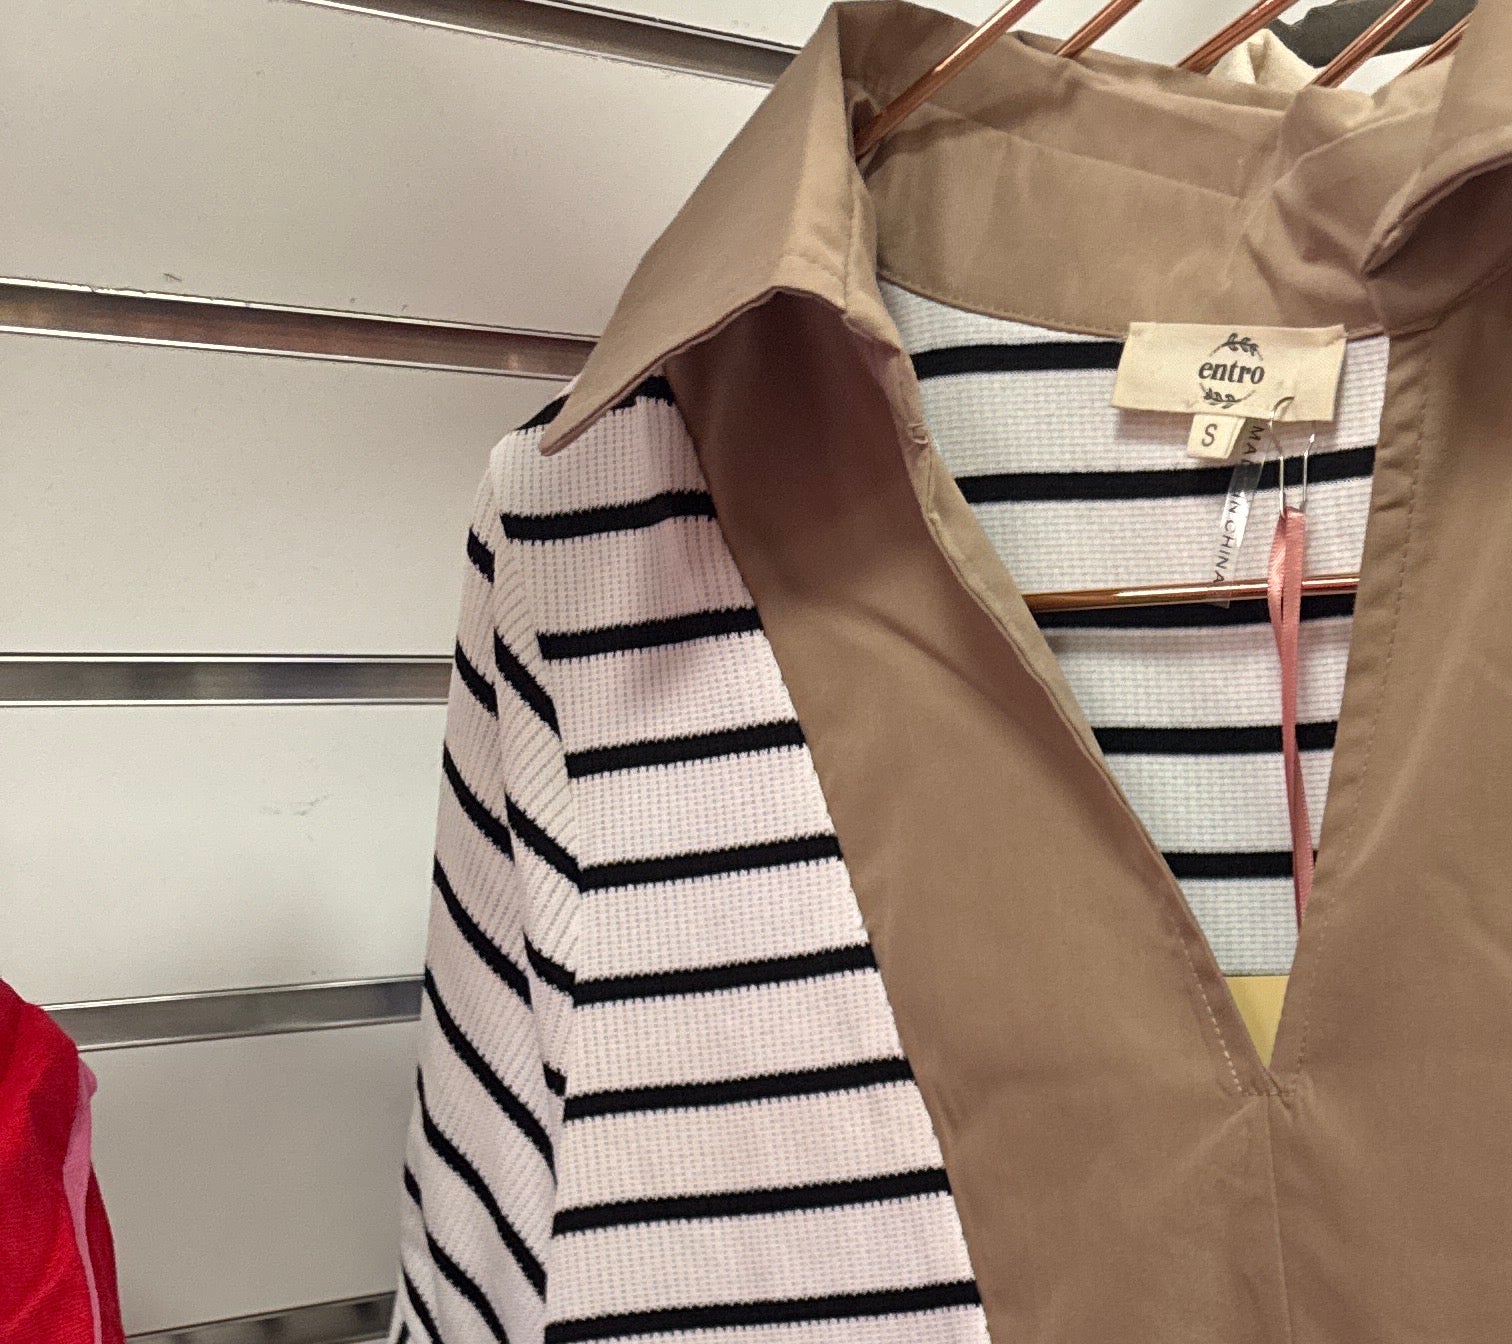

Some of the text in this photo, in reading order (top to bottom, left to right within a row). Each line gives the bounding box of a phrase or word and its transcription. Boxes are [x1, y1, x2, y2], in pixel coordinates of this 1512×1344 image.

[1198, 360, 1265, 385] entro
[1201, 423, 1218, 447] S
[1212, 519, 1238, 584] CHINA
